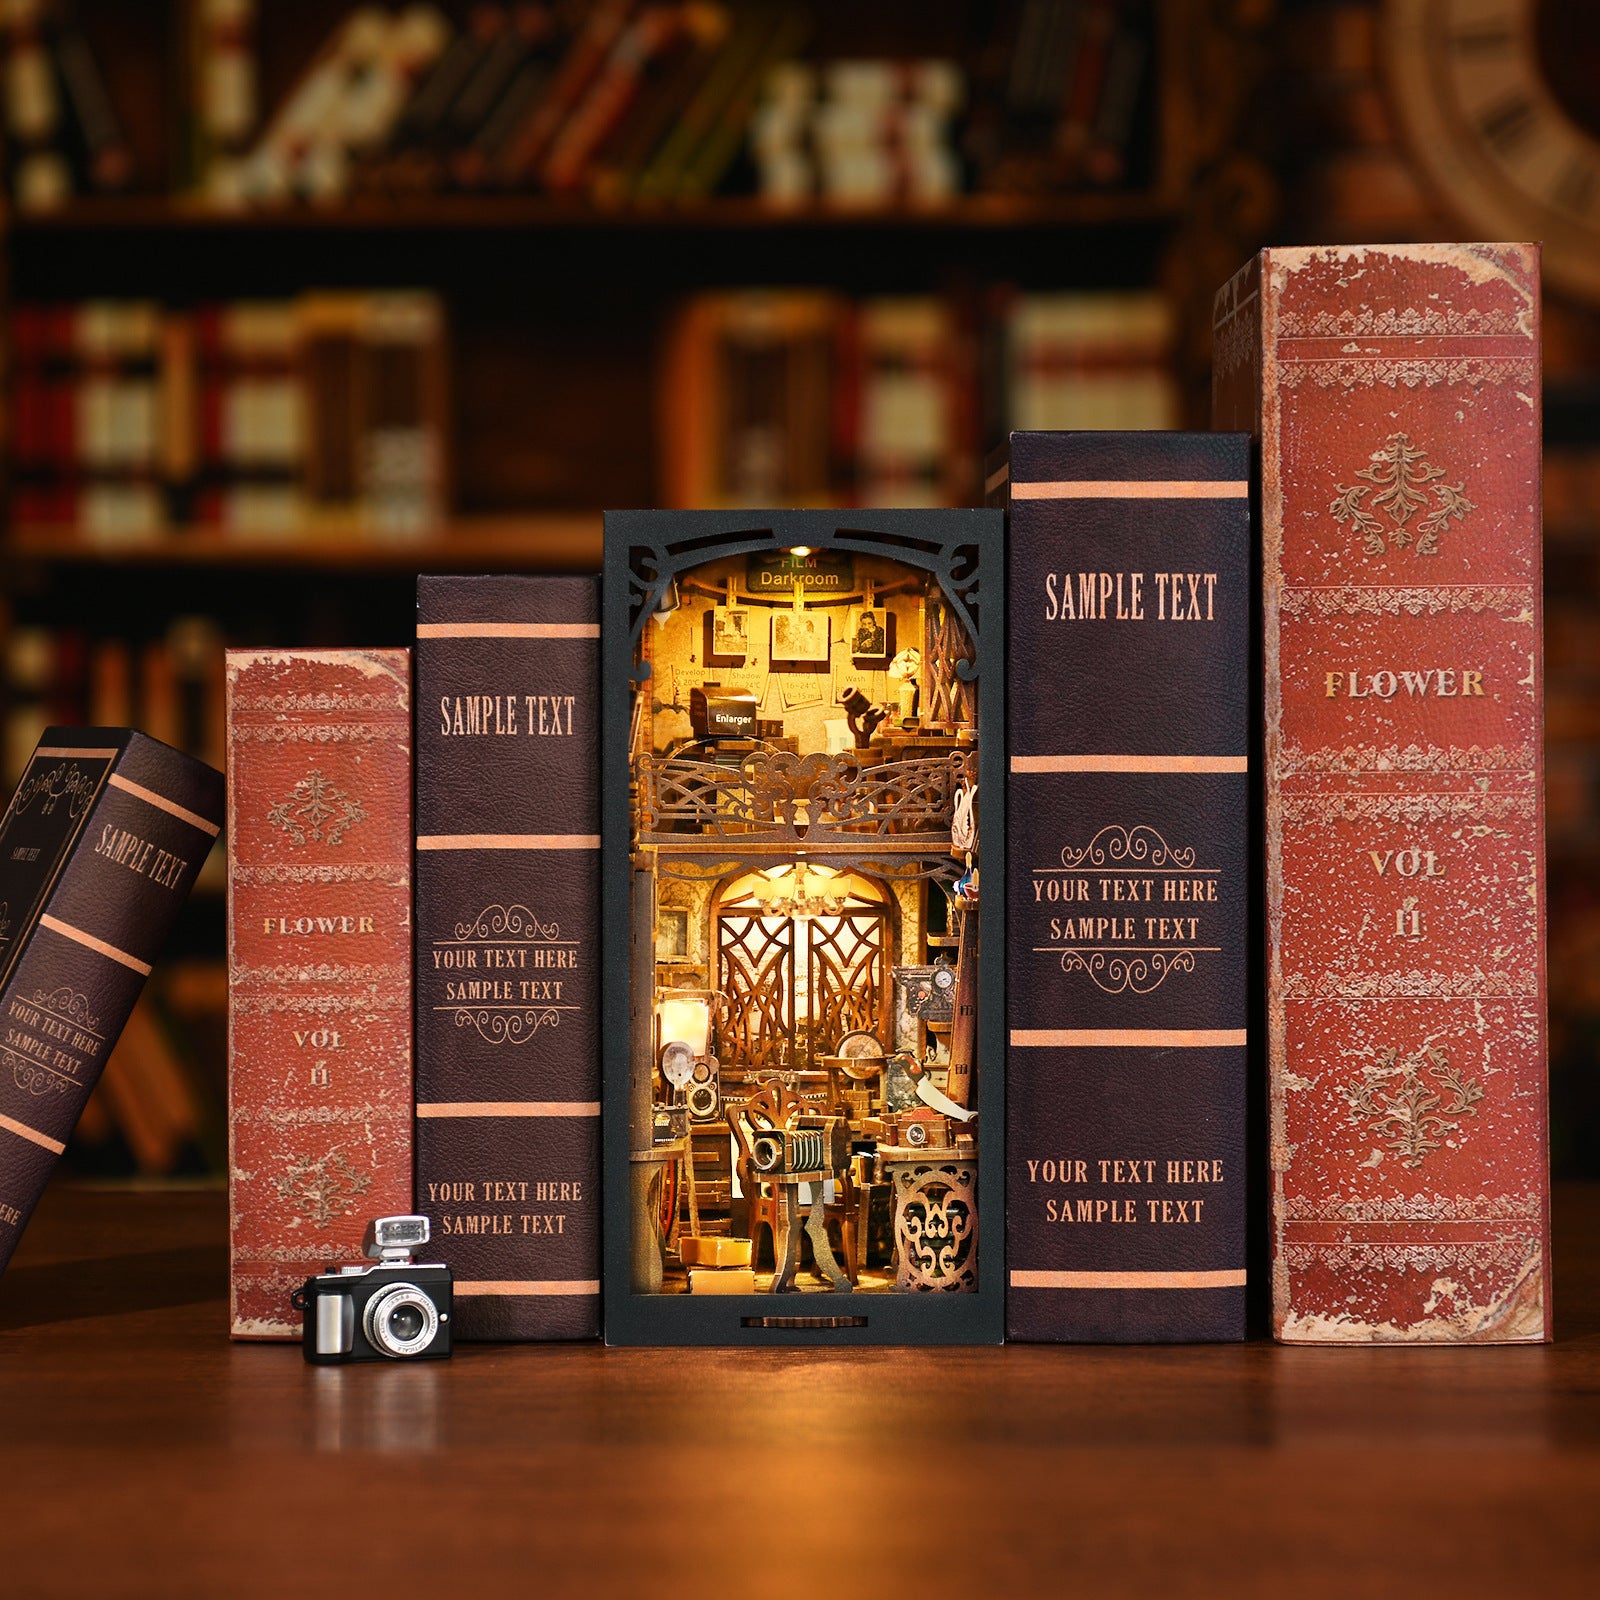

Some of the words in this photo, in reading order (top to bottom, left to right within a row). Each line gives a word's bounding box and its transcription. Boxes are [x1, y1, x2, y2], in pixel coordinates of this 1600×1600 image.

[781, 558, 817, 568] FILM
[761, 572, 839, 585] Darkroom
[1046, 573, 1143, 620] SAMPLE
[1154, 573, 1217, 620] TEXT
[675, 668, 706, 677] Develop
[1325, 670, 1486, 698] FLOWER
[441, 696, 518, 736] SAMPLE
[525, 696, 575, 736] TEXT
[715, 714, 752, 725] Enlarger
[95, 823, 154, 873] SAMPLE
[148, 849, 188, 890] TEXT
[1369, 850, 1446, 877] VOL
[1032, 879, 1090, 902] YOUR
[1099, 879, 1154, 901] TEXT
[1163, 879, 1218, 902] HERE
[262, 915, 375, 935] FLOWER
[1050, 918, 1136, 940] SAMPLE
[1145, 918, 1200, 940] TEXT
[1395, 909, 1421, 936] II
[432, 950, 477, 969] YOUR
[484, 949, 527, 968] TEXT
[534, 950, 578, 968] HERE
[446, 981, 513, 1000] SAMPLE
[519, 981, 563, 1000] TEXT
[8, 1001, 40, 1027] YOUR
[41, 1017, 72, 1042] TEXT
[71, 1032, 101, 1056] HERE
[292, 1030, 346, 1048] VOL
[6, 1028, 52, 1060] SAMPLE
[53, 1050, 82, 1074] TEXT
[310, 1068, 328, 1086] II
[1027, 1160, 1088, 1183] YOUR
[1098, 1160, 1157, 1183] TEXT
[1166, 1160, 1224, 1183] HERE
[428, 1182, 475, 1202] YOUR
[482, 1182, 529, 1201] TEXT
[536, 1182, 582, 1201] HERE
[0, 1203, 21, 1226] ERE
[1046, 1200, 1137, 1223] SAMPLE
[1147, 1200, 1204, 1223] TEXT
[442, 1215, 513, 1235] SAMPLE
[520, 1215, 566, 1234] TEXT
